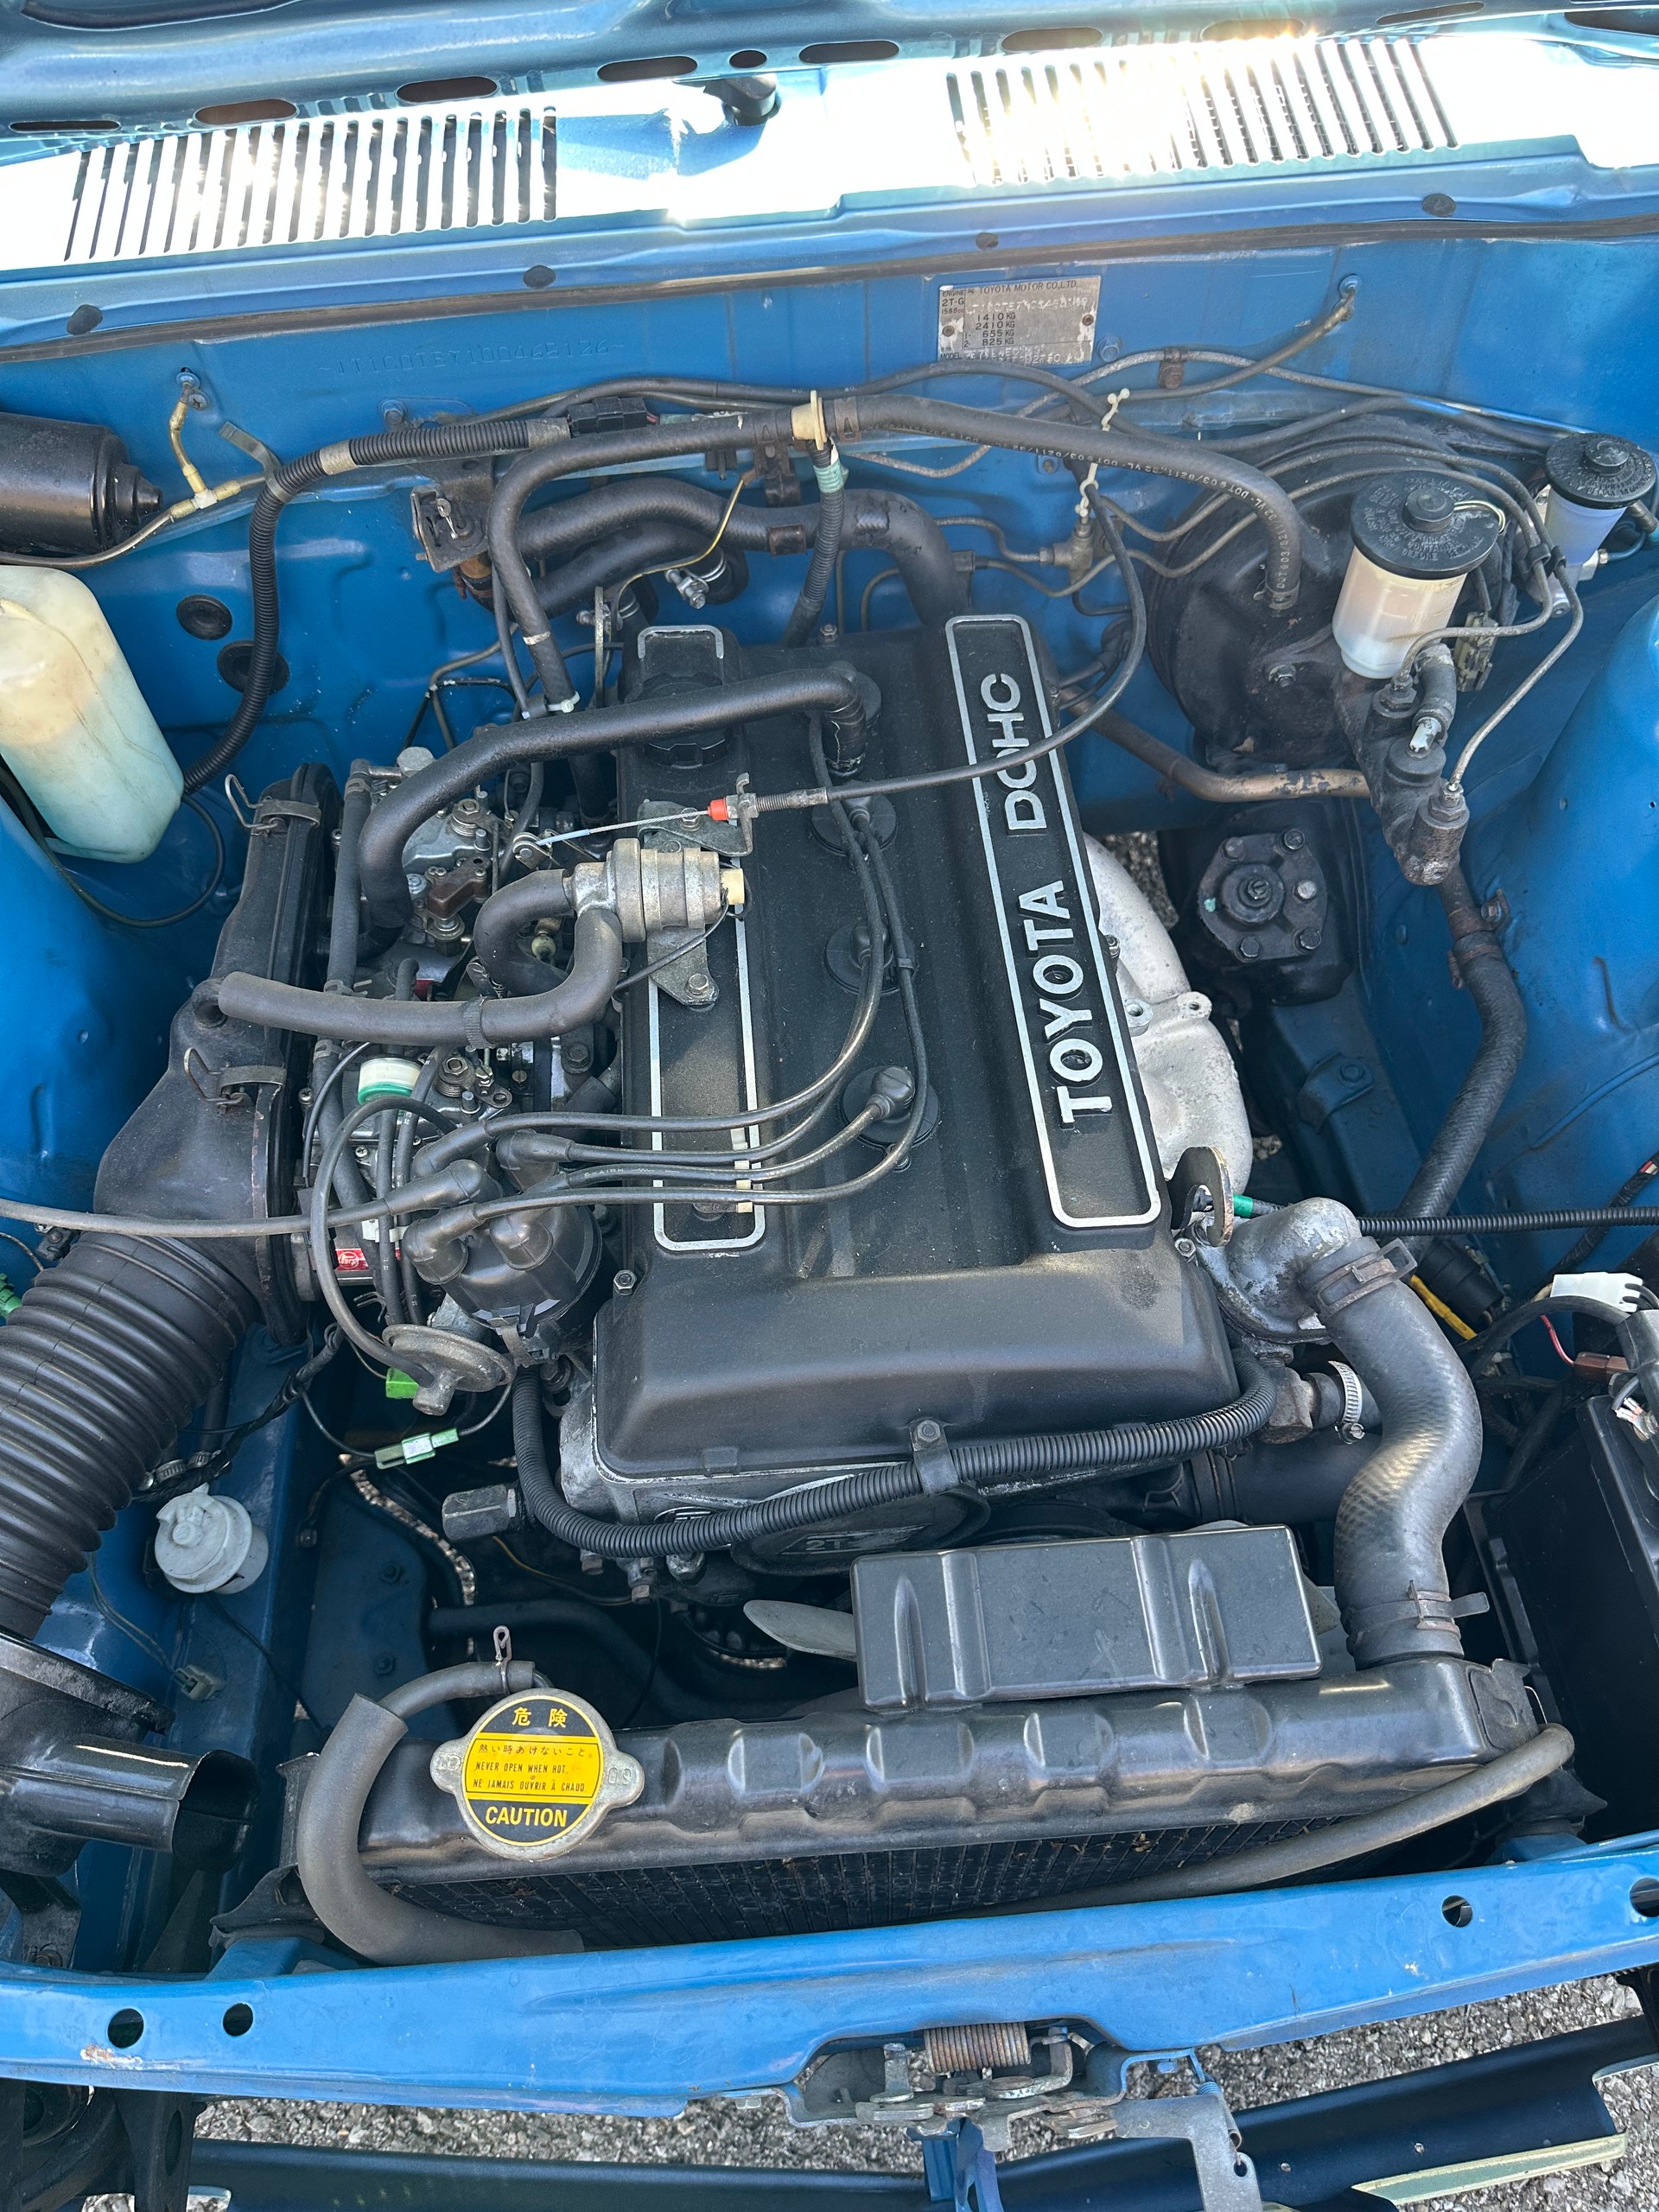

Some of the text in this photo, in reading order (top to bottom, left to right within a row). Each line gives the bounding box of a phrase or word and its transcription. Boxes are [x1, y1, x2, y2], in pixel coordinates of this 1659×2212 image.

[980, 284, 1011, 294] TOYOTA
[1014, 282, 1044, 291] MOTOR
[942, 297, 964, 307] 2T-G
[977, 313, 1004, 321] 1410
[976, 321, 1003, 330] 2410
[1227, 484, 1250, 499] DOT
[980, 672, 1113, 1124] TOYOTA DOHC
[512, 1707, 569, 1728] 危険
[476, 1761, 499, 1771] NEVER
[504, 1763, 523, 1772] OPEN
[528, 1764, 548, 1773] WHEN
[473, 1779, 482, 1788] NE
[487, 1779, 514, 1789] JAMAIS
[519, 1781, 546, 1791] OUVRIR
[485, 1805, 568, 1827] CAUTION
